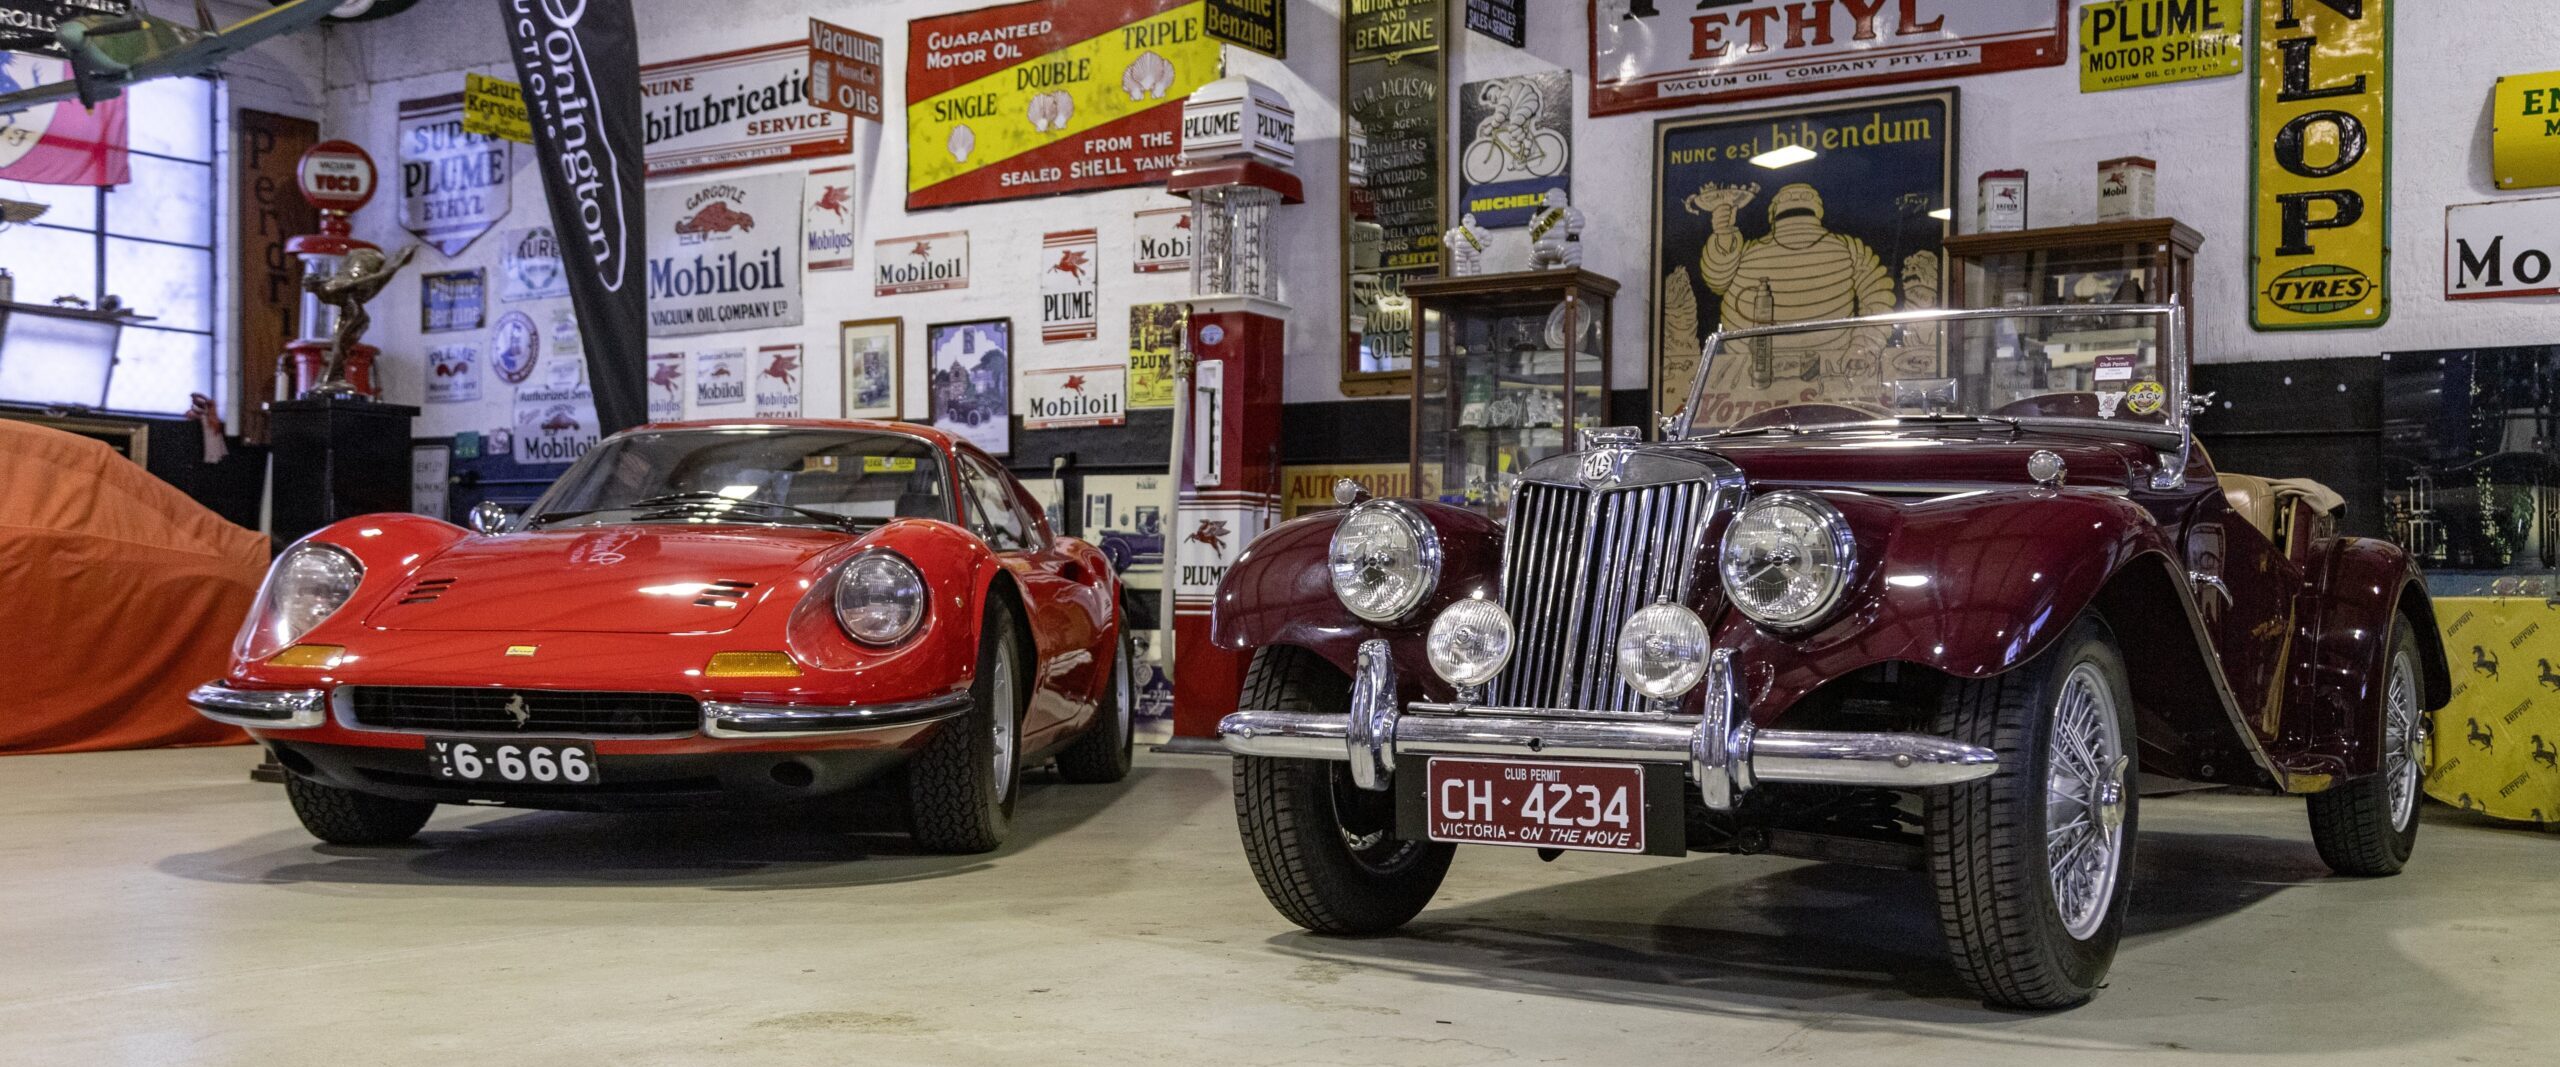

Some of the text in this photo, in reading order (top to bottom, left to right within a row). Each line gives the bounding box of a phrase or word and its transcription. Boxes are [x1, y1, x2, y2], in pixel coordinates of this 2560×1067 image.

[1208, 4, 1273, 49] Benzine
[1380, 9, 1406, 23] AND
[2093, 0, 2224, 46] PLUME
[810, 21, 880, 65] Vacuum
[927, 20, 1052, 51] GUARANTEED
[1122, 17, 1198, 51] TRIPLE
[1356, 18, 1434, 51] BENZINE
[1688, 0, 1945, 61] ETHYL
[927, 42, 1022, 71] MOTOR OIL
[2089, 35, 2229, 73] MOTOR SPIRIT
[1017, 58, 1090, 90] DOUBLE
[1664, 75, 1737, 93] VACUUM
[1747, 71, 1773, 83] OIL
[1786, 58, 1885, 80] COMPANY
[1934, 48, 1972, 63] LTD.
[2102, 73, 2139, 84] VACUUM
[2145, 70, 2159, 79] OIL
[645, 68, 809, 146] bilubricati
[838, 84, 879, 115] Oils
[935, 92, 997, 123] SINGLE
[747, 112, 832, 136] SERVICE
[1184, 111, 1241, 138] PLUME
[1257, 113, 1295, 146] PLUME
[1084, 131, 1173, 154] FROM THE
[1671, 112, 1931, 165] NUNC est bibendum
[404, 149, 504, 198] PLUME
[1001, 167, 1062, 187] SEALED
[1070, 155, 1127, 180] SHELL
[1360, 168, 1427, 187] STANDARDS
[686, 184, 746, 210] GARGOYLE
[2102, 185, 2127, 197] Mobil
[423, 197, 484, 221] ETHYL
[808, 229, 853, 254] Mobilgas
[650, 246, 785, 300] Mobiloil
[880, 257, 961, 284] Mobiloil
[2456, 235, 2552, 289] Mo
[2275, 277, 2364, 301] TYRES
[651, 308, 694, 326] VACUUM
[699, 305, 716, 323] OIL
[719, 301, 769, 322] COMPANY
[1043, 290, 1094, 321] PLUME
[1371, 331, 1412, 358] OILS
[697, 381, 745, 400] Mobiloil
[756, 392, 799, 408] Mobilgas
[1029, 392, 1118, 418] Mobiloil
[1182, 565, 1229, 586] PLUM
[2447, 610, 2474, 637] Ferrari
[2510, 621, 2540, 649] Ferrari
[2503, 698, 2534, 725] Ferrari
[1504, 767, 1561, 782] CLUB PERMIT
[2432, 756, 2462, 784] Ferrari
[2499, 770, 2531, 798] Ferrari
[1520, 826, 1543, 841] ON
[1550, 828, 1581, 843] THE
[1583, 830, 1632, 847] MOVE
